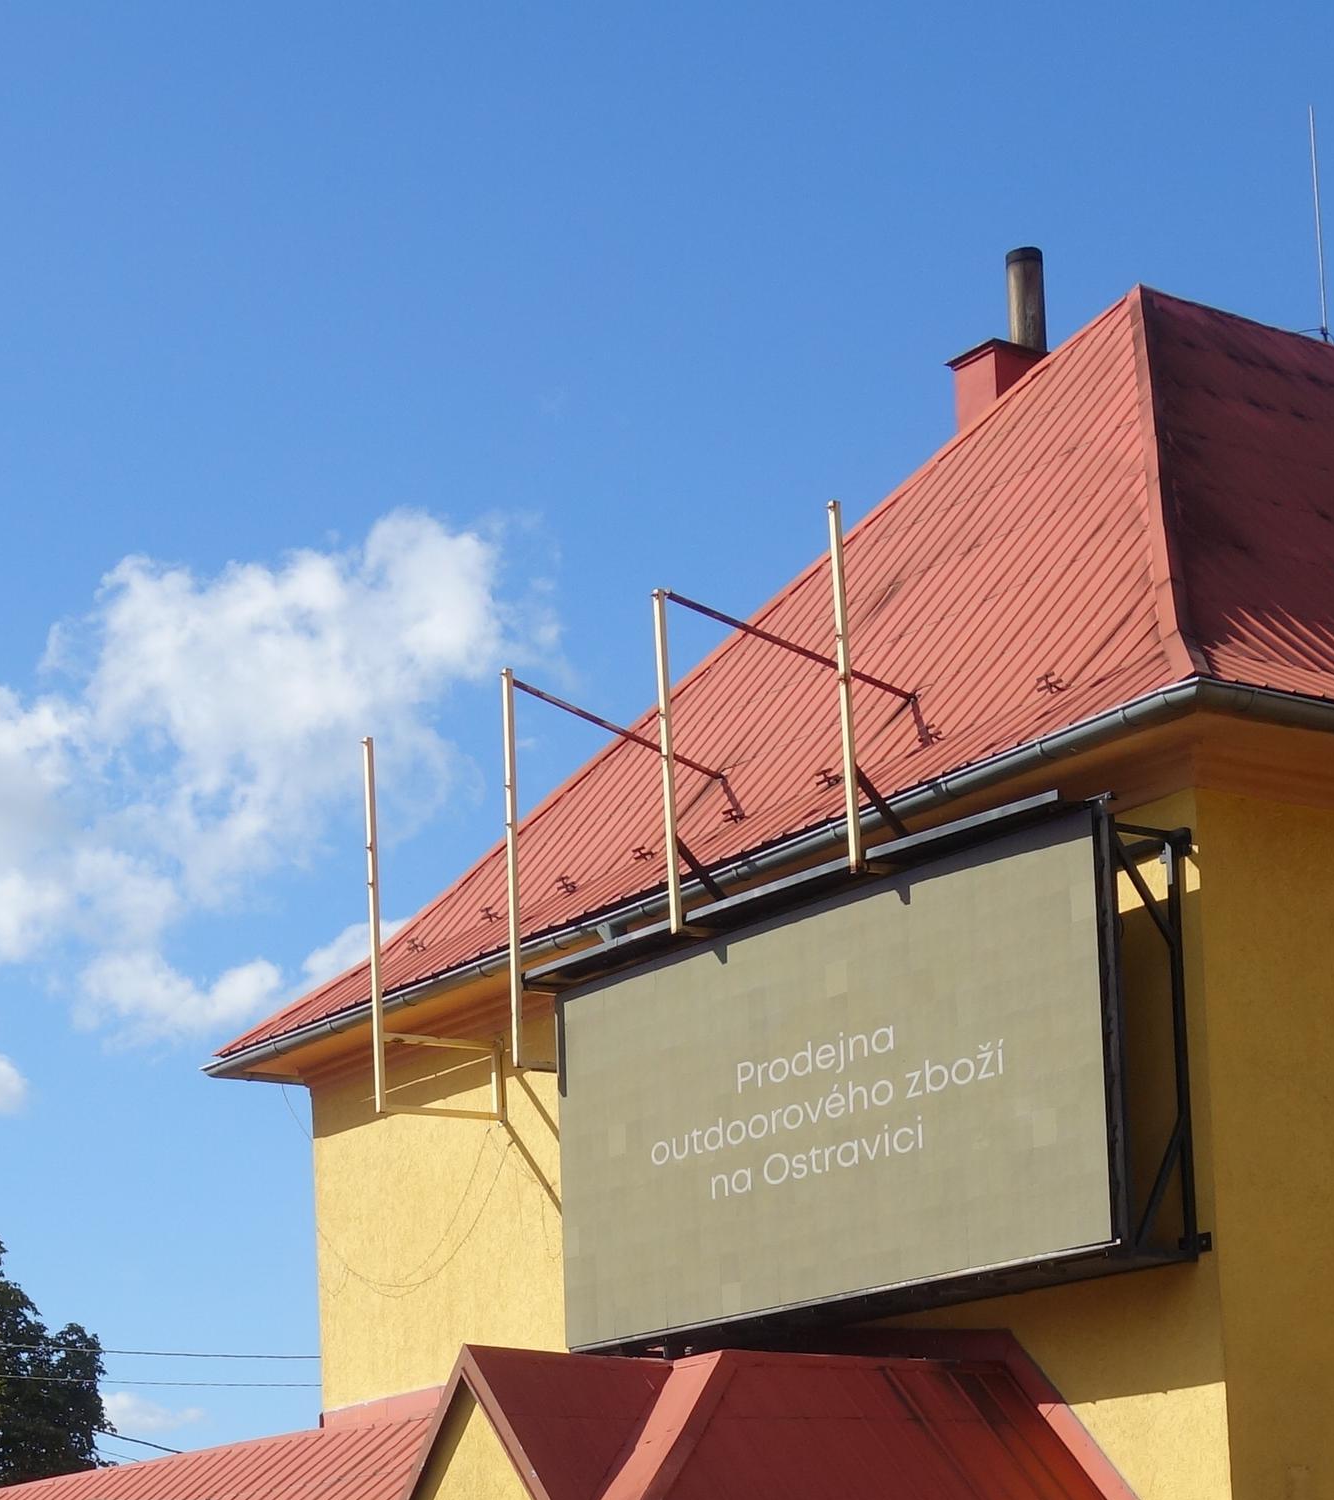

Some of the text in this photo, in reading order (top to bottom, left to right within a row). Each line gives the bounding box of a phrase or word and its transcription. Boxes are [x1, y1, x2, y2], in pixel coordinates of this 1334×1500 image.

[736, 1024, 895, 1094] Prodejna
[651, 1038, 1004, 1166] outdoorového zboží
[711, 1115, 924, 1200] na Ostravici
